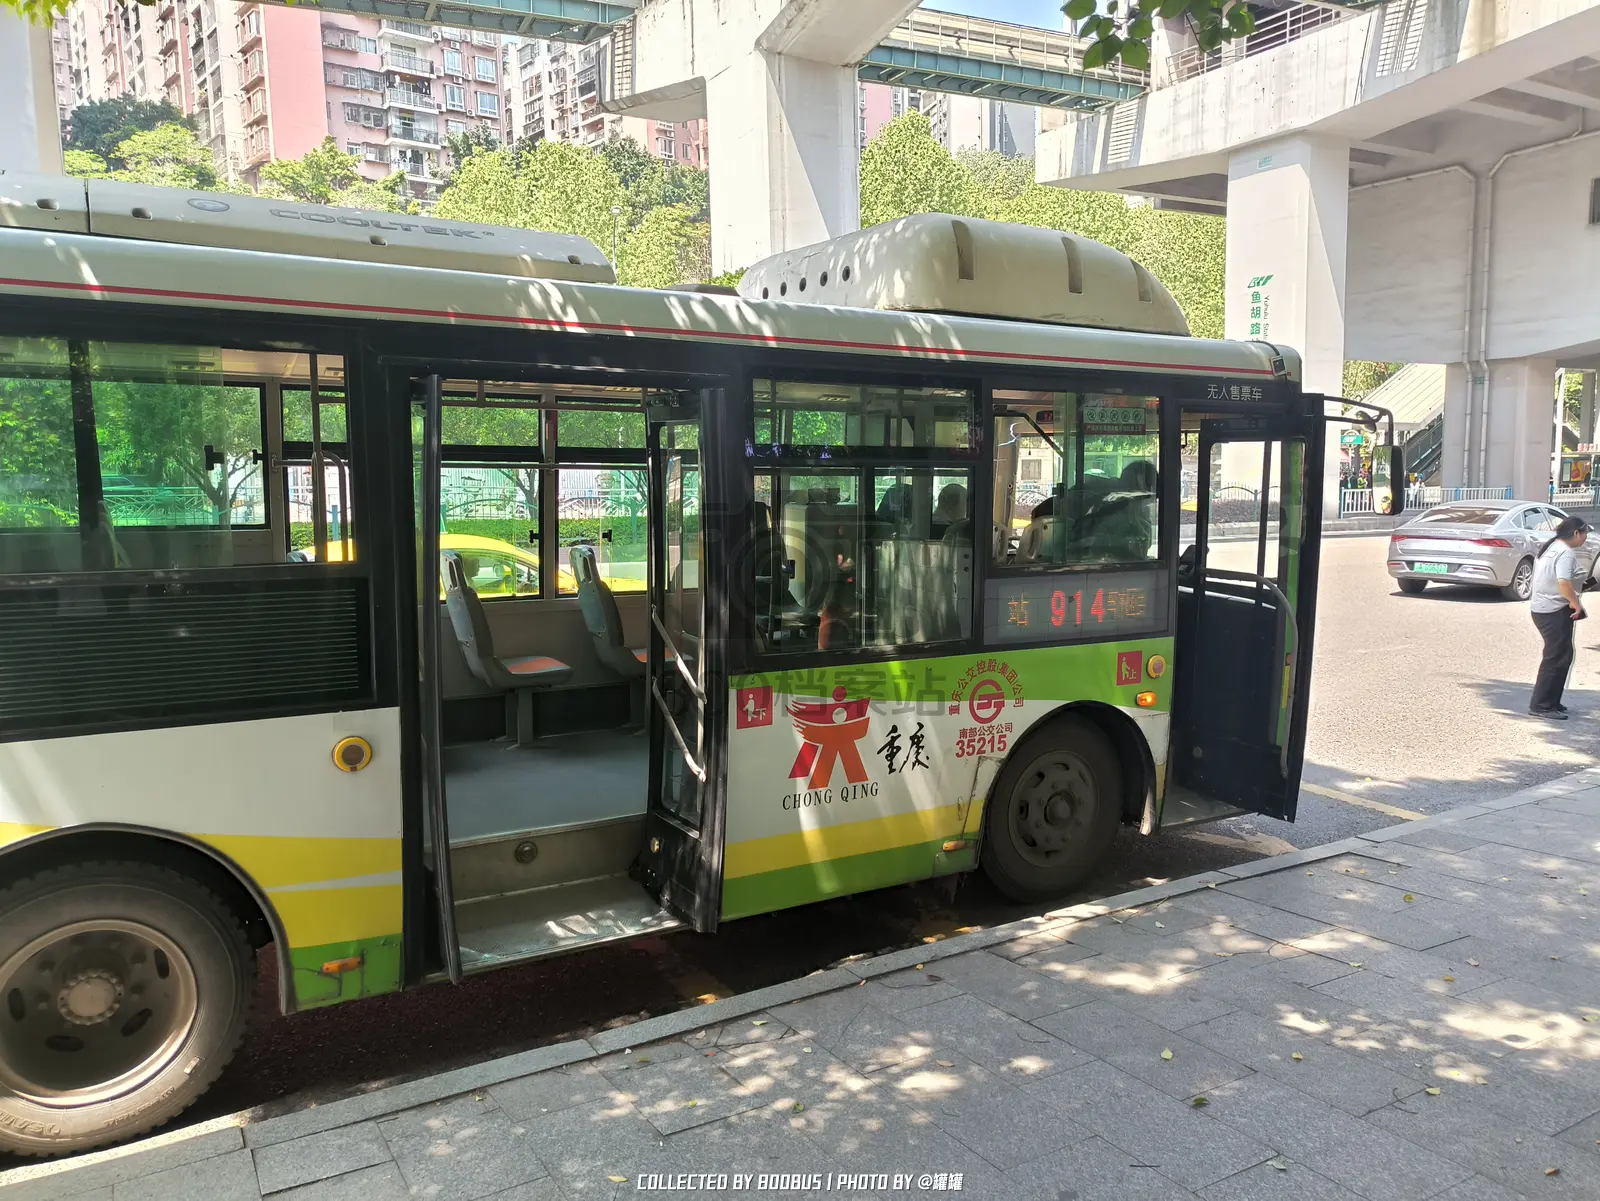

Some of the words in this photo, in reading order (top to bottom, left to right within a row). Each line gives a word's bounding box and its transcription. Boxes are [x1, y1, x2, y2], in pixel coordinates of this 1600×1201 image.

[1249, 290, 1263, 340] 鱼胡路
[1207, 383, 1263, 402] 无人售票车
[1050, 587, 1105, 627] 914
[959, 722, 1013, 740] 南部公交公司
[955, 733, 1008, 759] 35215
[782, 789, 833, 811] CHONG
[840, 781, 880, 804] QING
